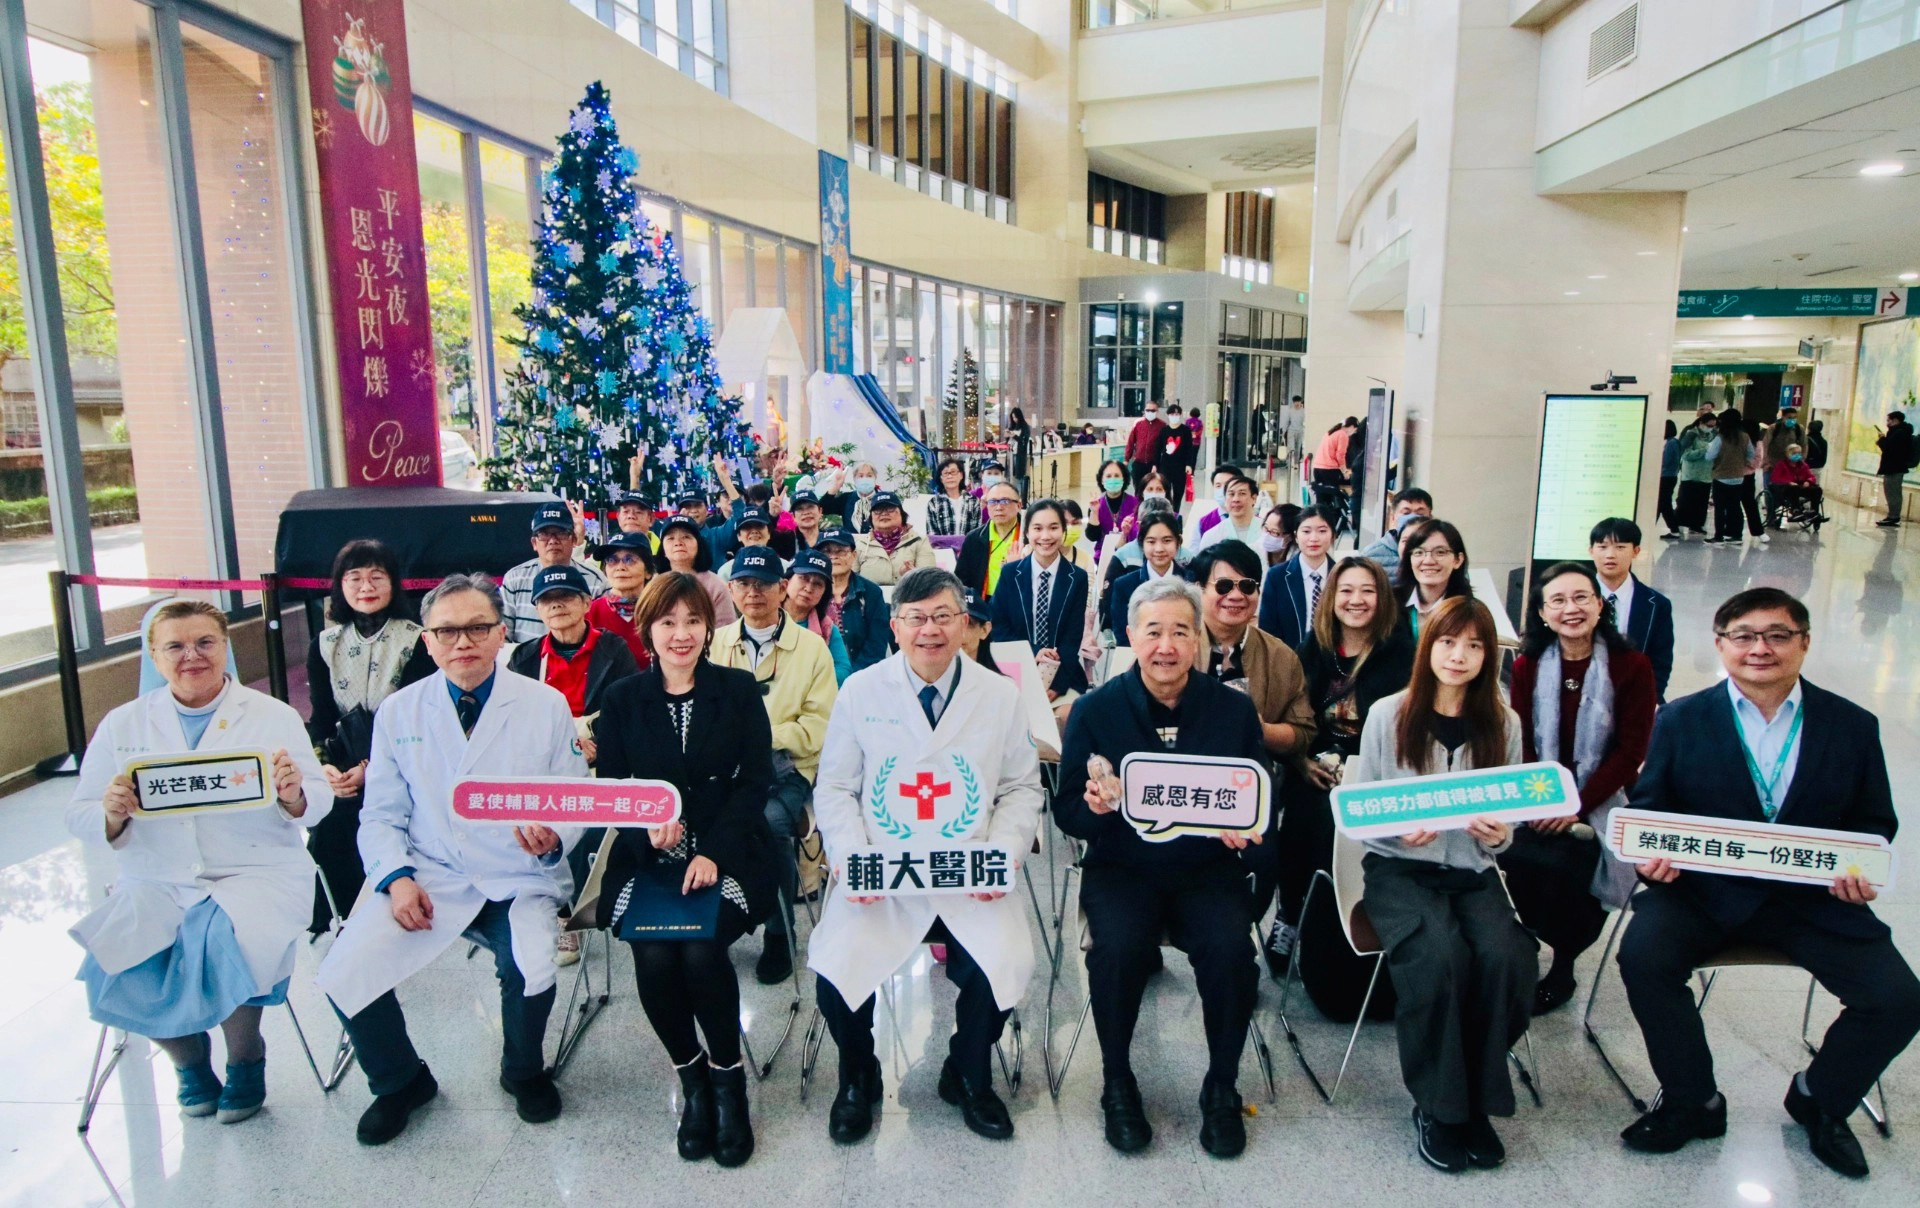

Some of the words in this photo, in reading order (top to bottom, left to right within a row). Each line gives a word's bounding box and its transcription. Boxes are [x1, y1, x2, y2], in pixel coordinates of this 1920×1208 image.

[377, 188, 409, 326] 平安夜
[350, 206, 389, 398] 恩光閃爍
[362, 420, 431, 482] Peace
[470, 515, 497, 523] KAWAI
[543, 510, 561, 518] FJCU
[743, 557, 766, 566] FJCU
[808, 557, 827, 568] FJCU
[544, 572, 567, 582] FJCU
[148, 773, 227, 796] 光芒萬丈
[468, 792, 631, 813] 愛使輔醫人相聚一起
[1141, 784, 1238, 810] 感恩有您
[1346, 781, 1523, 818] 每份努力都值得被看見
[1638, 830, 1839, 871] 榮耀來自每一份堅持
[847, 849, 1008, 891] 輔大醫院
